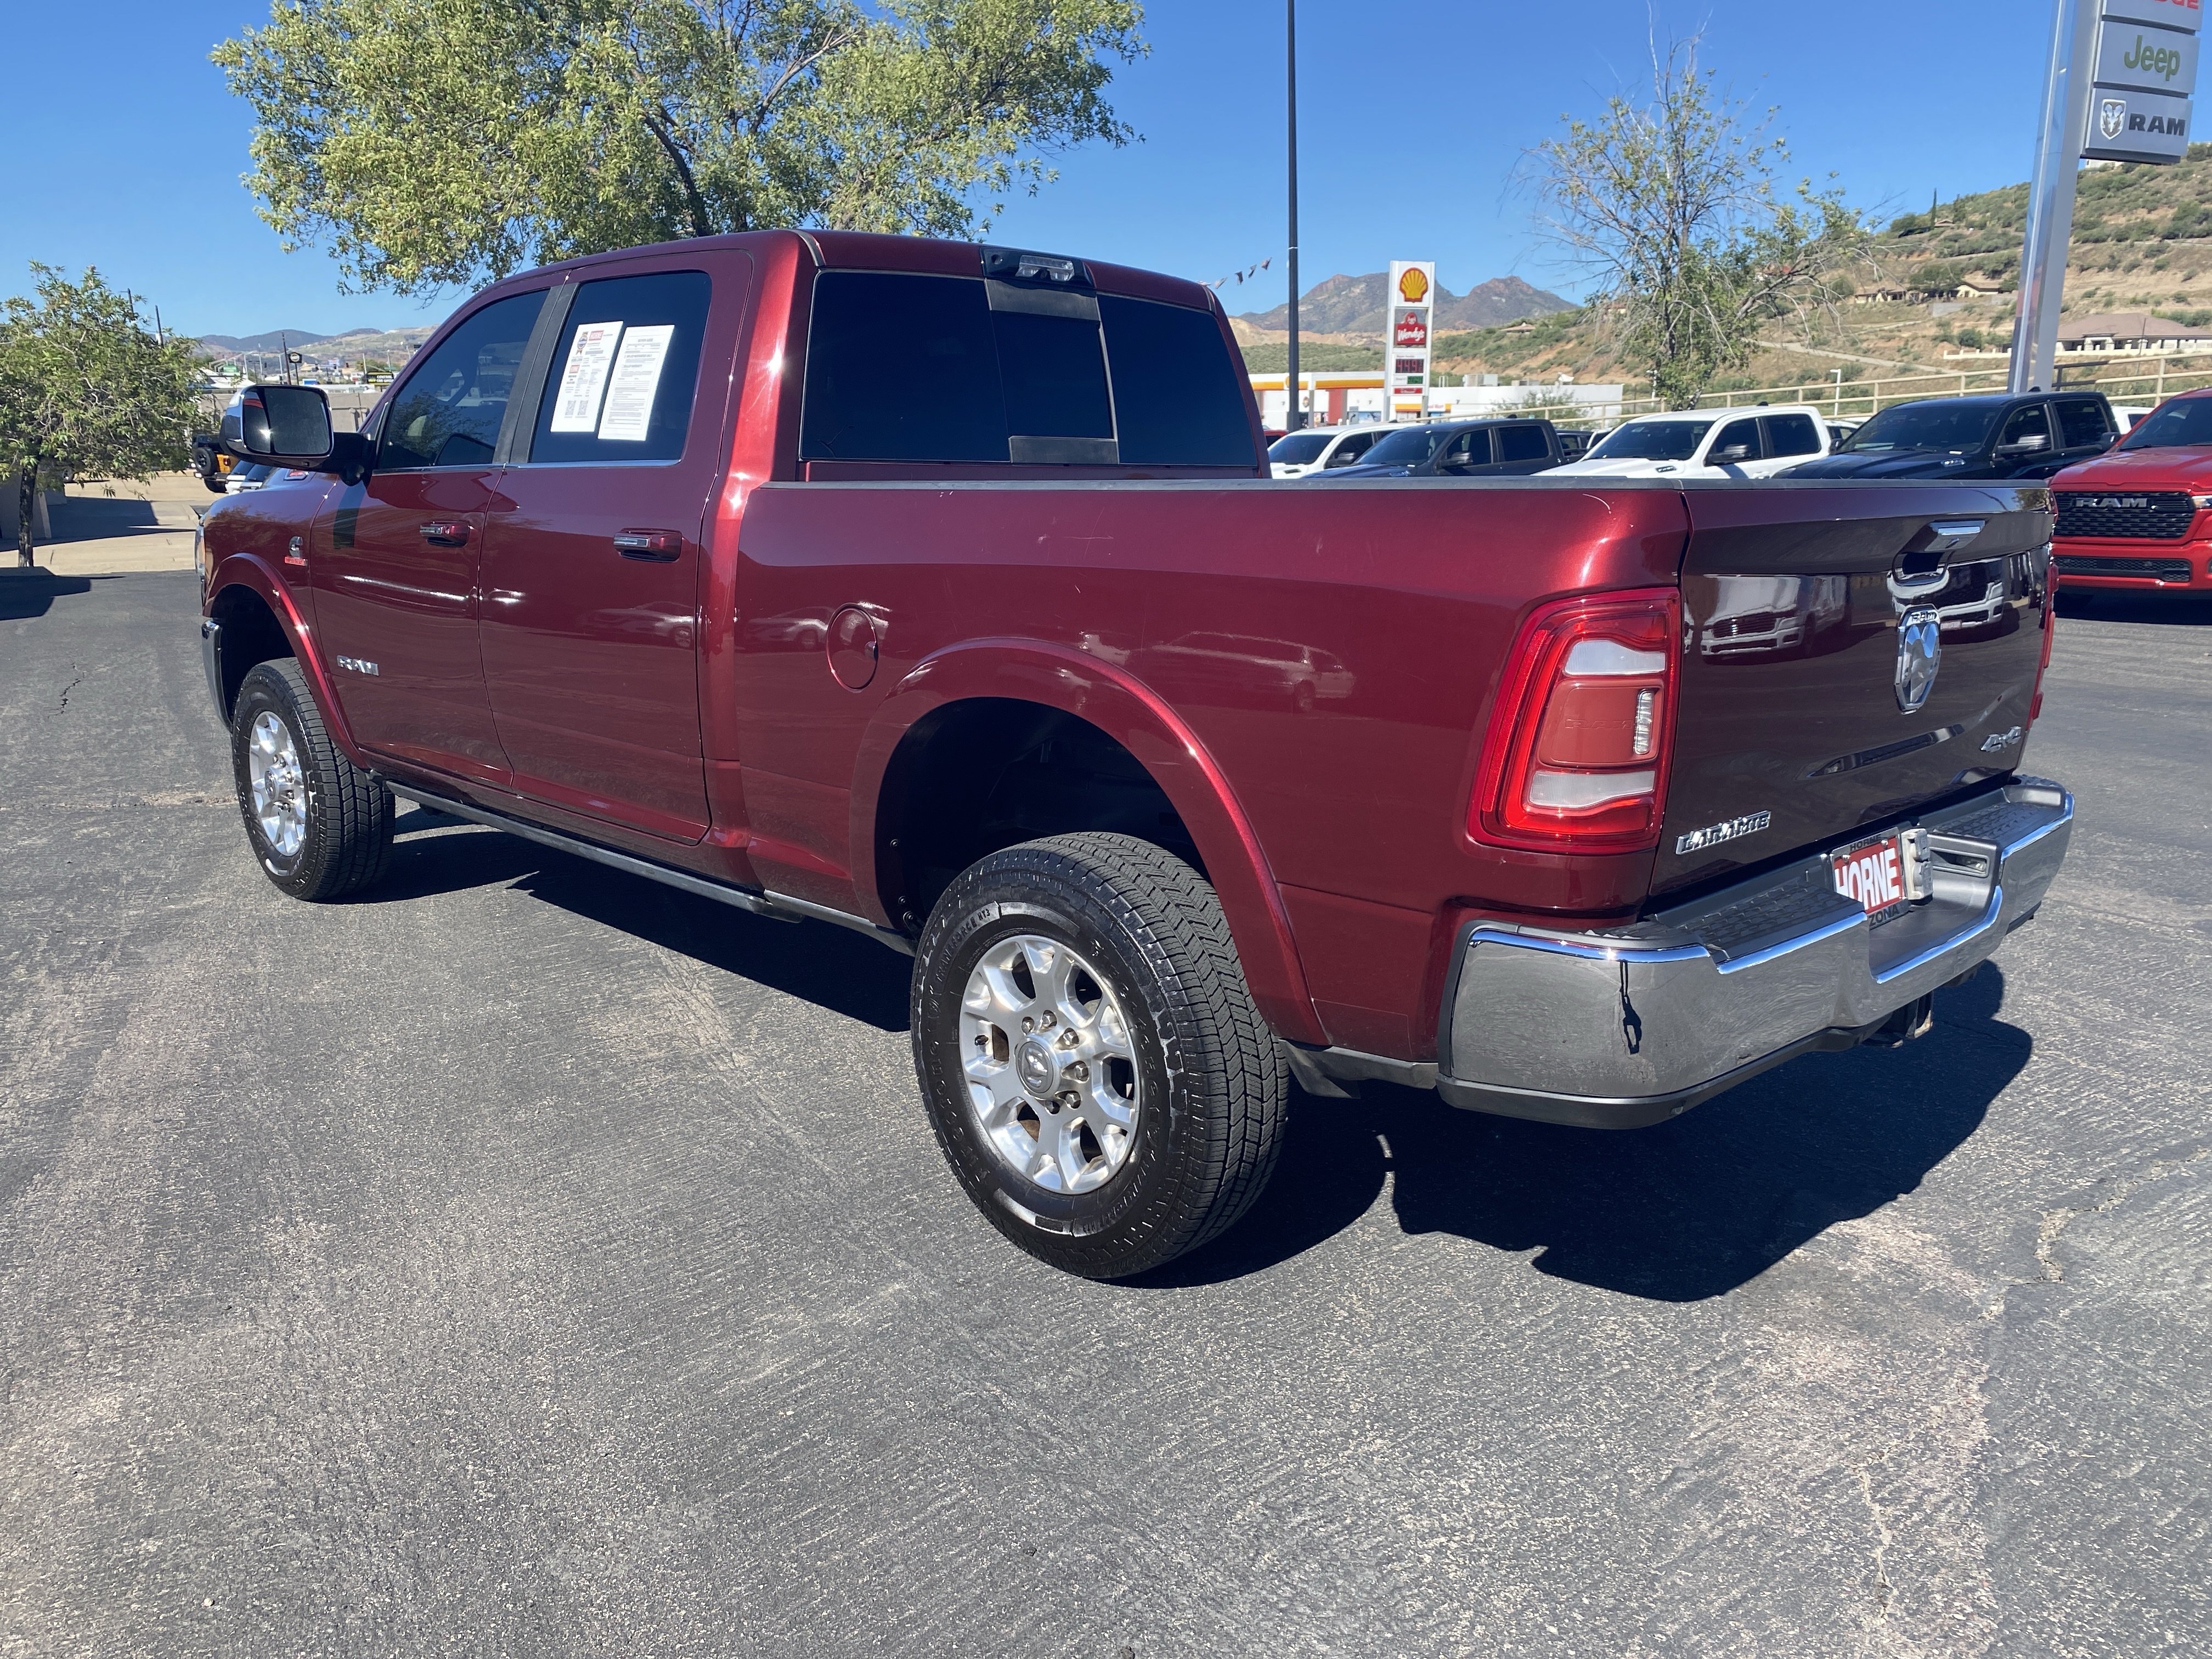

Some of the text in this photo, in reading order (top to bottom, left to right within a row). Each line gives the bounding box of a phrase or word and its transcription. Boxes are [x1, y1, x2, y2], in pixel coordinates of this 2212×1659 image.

[2124, 35, 2181, 81] Jeep
[2129, 113, 2186, 136] RAM
[2075, 497, 2147, 507] RAM
[337, 654, 379, 676] RAM
[1565, 719, 1633, 729] RAM
[1676, 810, 1771, 855] LARAMIE
[1850, 834, 1881, 851] HORNE
[1835, 848, 1900, 910] HORNE
[977, 908, 991, 921] HT3
[1869, 905, 1899, 927] ZONA
